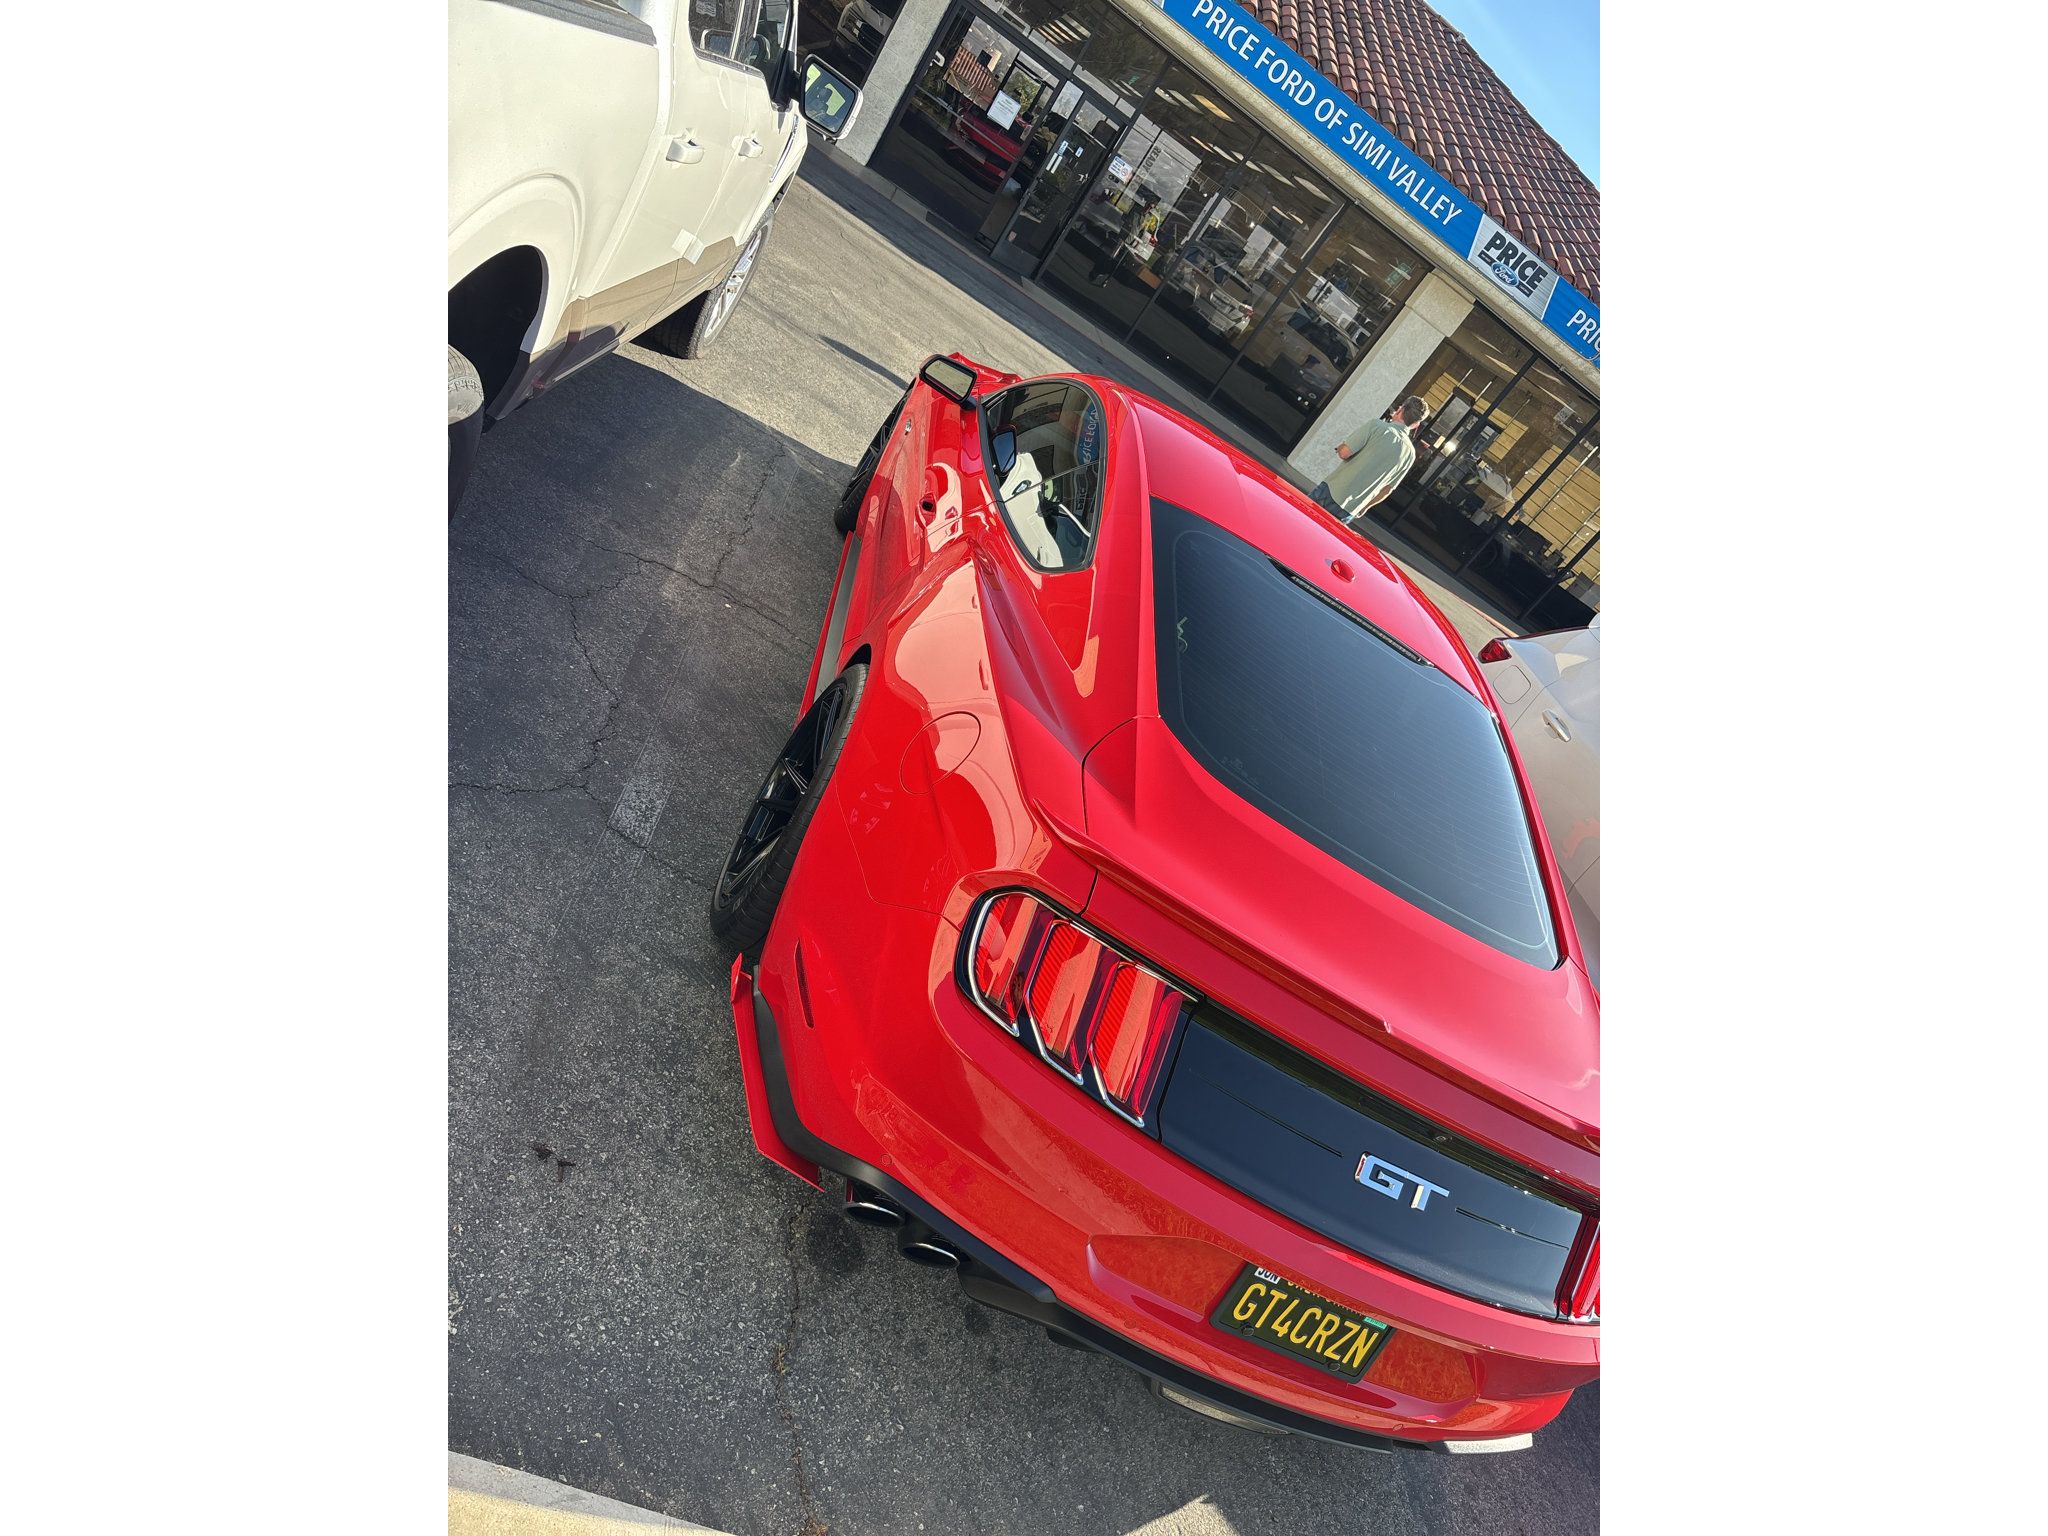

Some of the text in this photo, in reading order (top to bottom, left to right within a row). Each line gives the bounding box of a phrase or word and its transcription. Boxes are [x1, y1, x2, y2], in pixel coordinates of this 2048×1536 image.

[1191, 0, 1463, 225] PRICE FORD OF SIMI VALLEY
[1483, 230, 1549, 291] PRICE
[1493, 265, 1516, 285] Ford
[1355, 1152, 1450, 1212] GT
[1232, 1283, 1379, 1368] GT4CRZN
